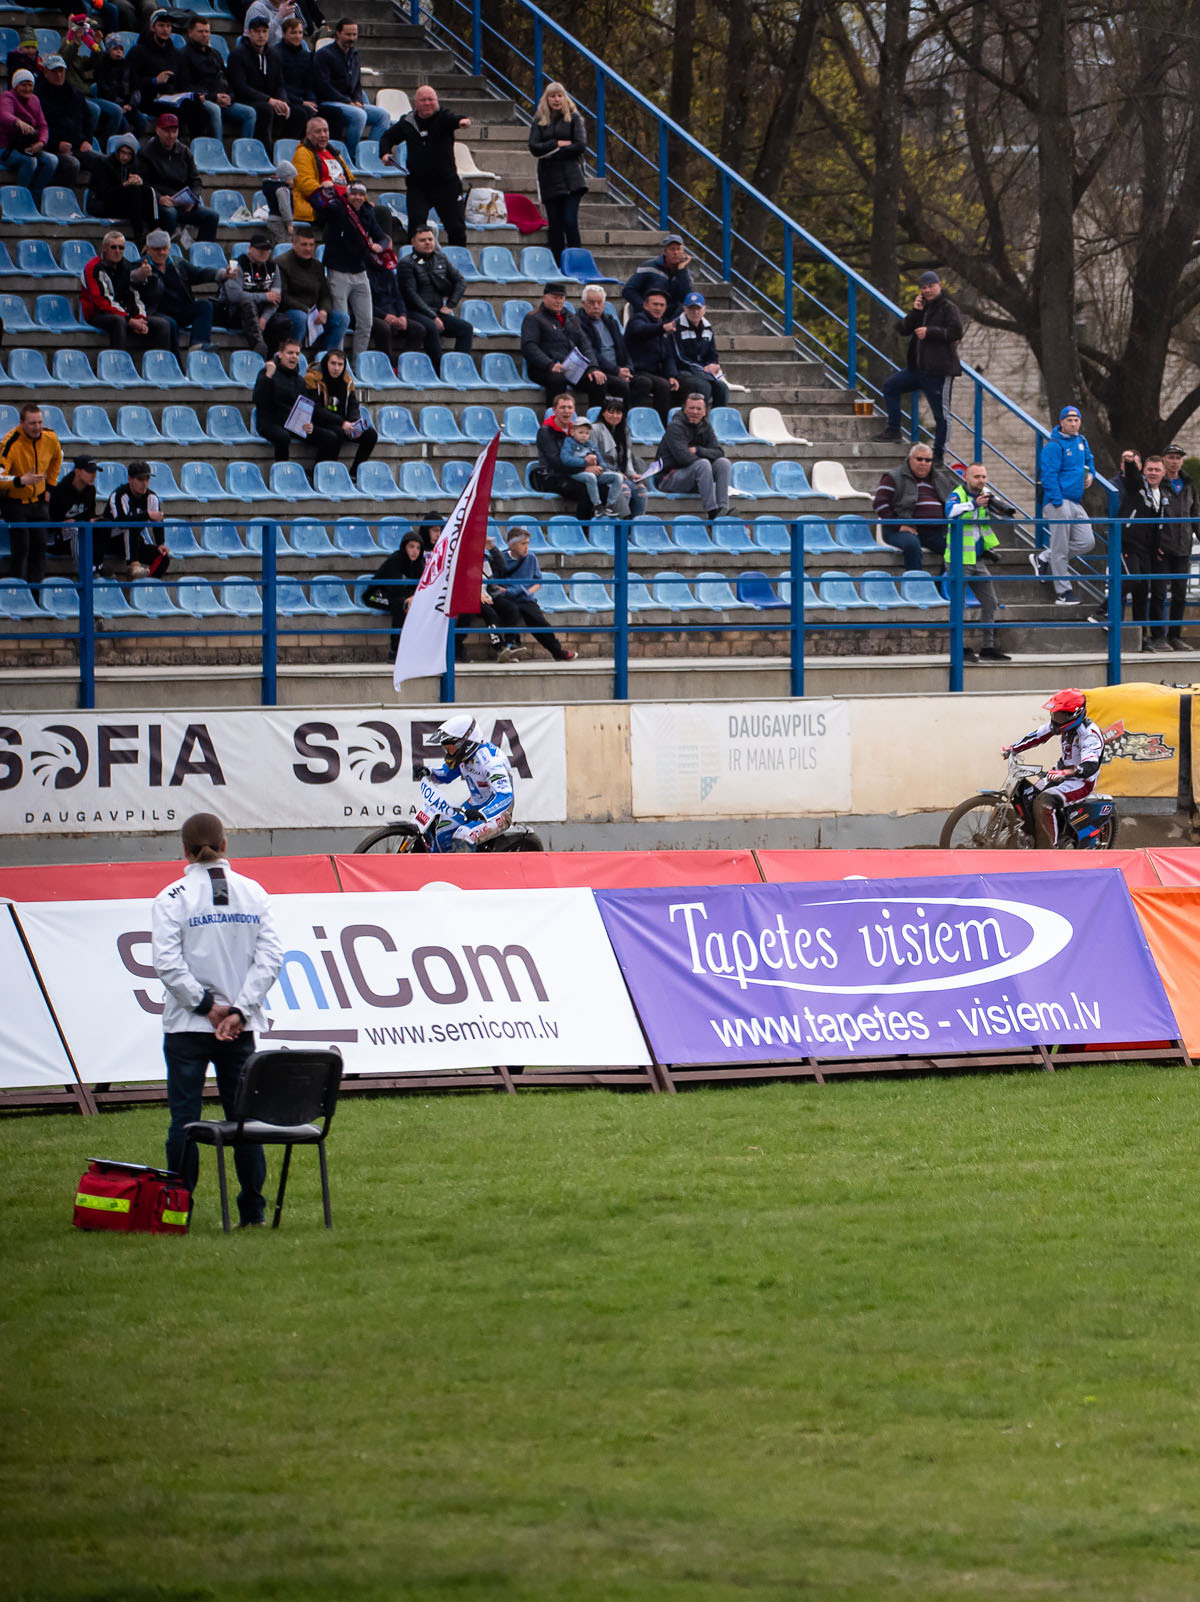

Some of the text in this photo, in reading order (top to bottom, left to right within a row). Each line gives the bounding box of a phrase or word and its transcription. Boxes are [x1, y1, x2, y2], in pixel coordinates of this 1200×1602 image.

[728, 713, 827, 738] DAUGAVPILS
[728, 746, 818, 771] IR MANA PILS
[25, 809, 176, 824] DAUGAVPILS
[669, 902, 1011, 990] Tapetes visiem
[117, 924, 550, 1016] SmiCom
[364, 1016, 560, 1046] www.semicom.lv
[710, 1007, 929, 1050] www.tapetes
[957, 992, 1101, 1036] visiem.lv
